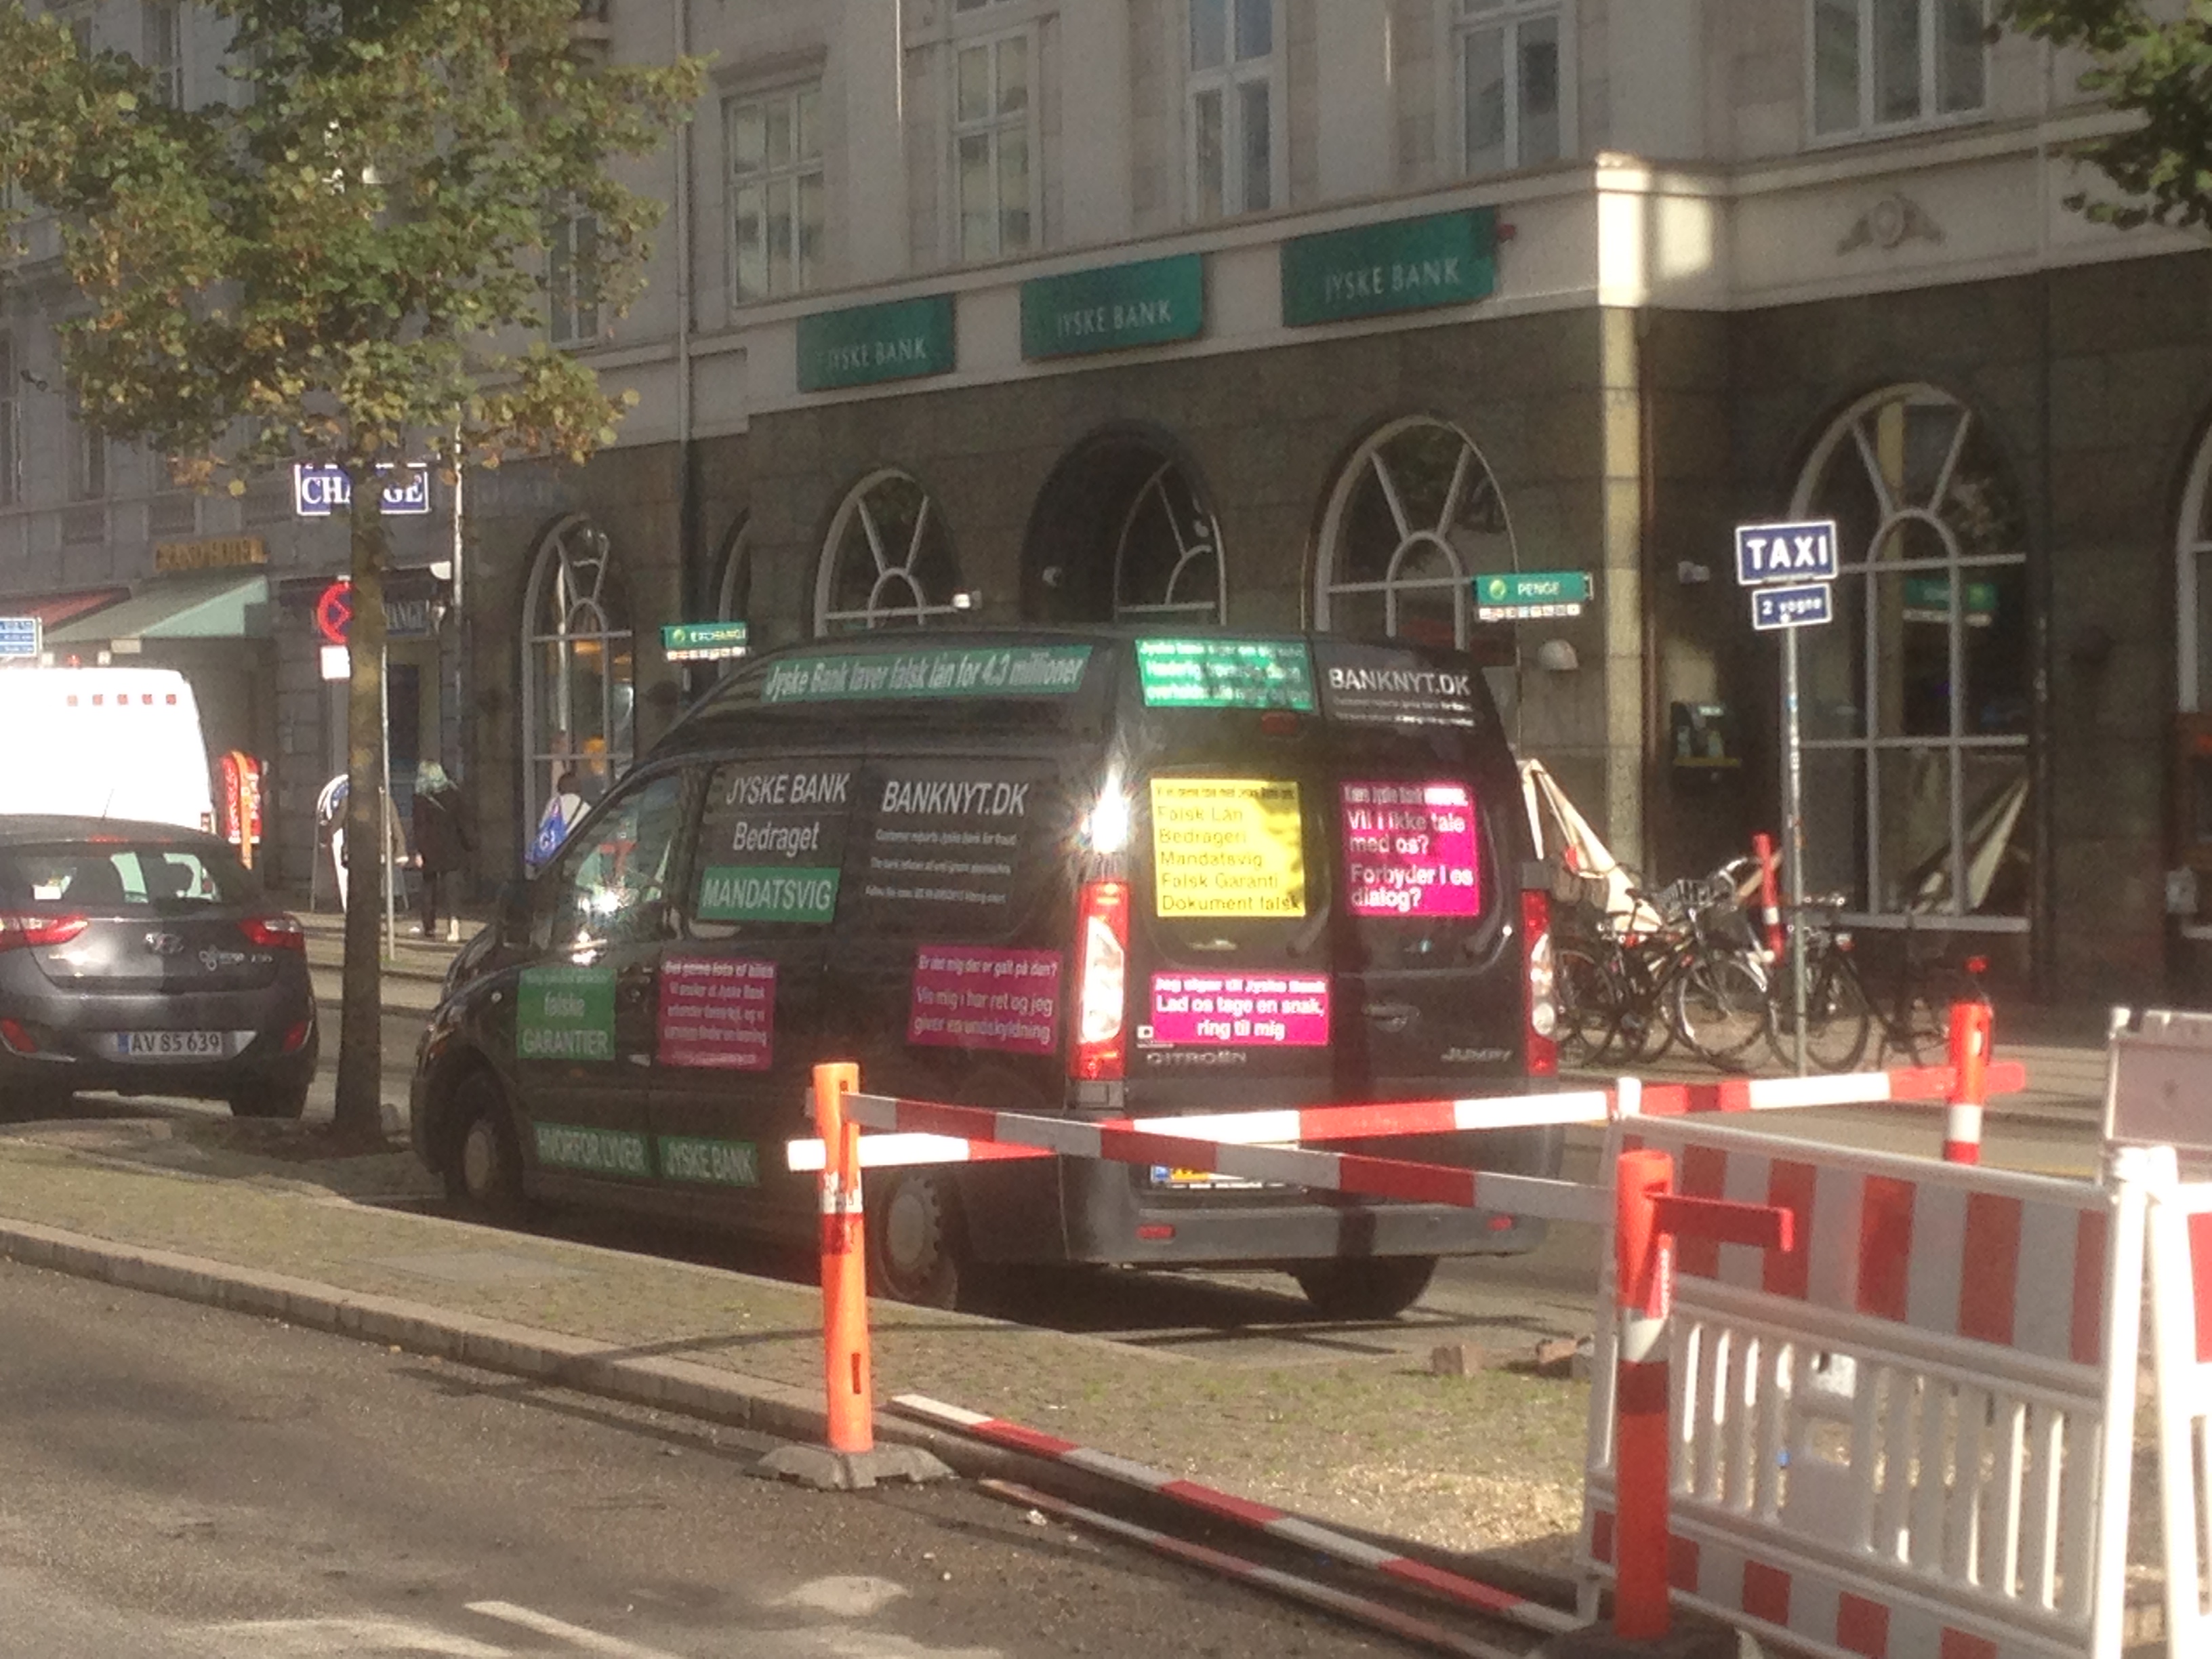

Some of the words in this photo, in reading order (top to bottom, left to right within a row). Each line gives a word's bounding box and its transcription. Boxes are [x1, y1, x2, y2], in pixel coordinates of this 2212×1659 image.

[1325, 266, 1384, 303] JYSKE
[1391, 257, 1460, 292] BANK
[1058, 306, 1105, 337] JYSKE
[1113, 299, 1172, 330] BANK
[875, 337, 926, 367] BANK
[1746, 535, 1828, 571] TAXI
[1517, 580, 1560, 597] PENGE
[1761, 600, 1773, 615] 2
[766, 663, 808, 702] Jyske
[811, 661, 848, 693] Bank
[955, 653, 982, 689] for
[1009, 651, 1084, 687] millioner
[1328, 668, 1471, 696] BANKNYT.DK
[726, 776, 787, 806] JYSKE
[791, 773, 851, 804] BANK
[881, 780, 1029, 817] BANKNYT.DK
[1158, 806, 1204, 821] Falsk
[1389, 811, 1427, 831] ikke
[1431, 811, 1466, 833] tale
[733, 821, 819, 858] Bedraget
[1160, 828, 1246, 848] Bedrageri
[1350, 834, 1389, 853] med
[1395, 834, 1429, 855] os?
[1161, 851, 1263, 871] Mandatsvig
[1162, 872, 1208, 889] Falsk
[1215, 872, 1278, 889] Garanti
[1351, 863, 1435, 890] Forbyder
[702, 878, 832, 912] MANDATSVIG
[1162, 895, 1253, 911] Dokument
[1261, 895, 1300, 911] falsk
[1351, 886, 1422, 913] dialog?
[1029, 993, 1054, 1017] jeg
[1156, 994, 1189, 1012] Lad
[1216, 996, 1253, 1016] tage
[1256, 1000, 1277, 1013] en
[132, 1033, 155, 1052] AV
[186, 1033, 220, 1052] 639
[523, 1027, 608, 1055] GARANTIER
[1197, 1019, 1231, 1040] ring
[1234, 1019, 1251, 1037] til
[1254, 1019, 1286, 1040] mig
[667, 1141, 712, 1179] JYSKE
[712, 1145, 756, 1183] BANK
